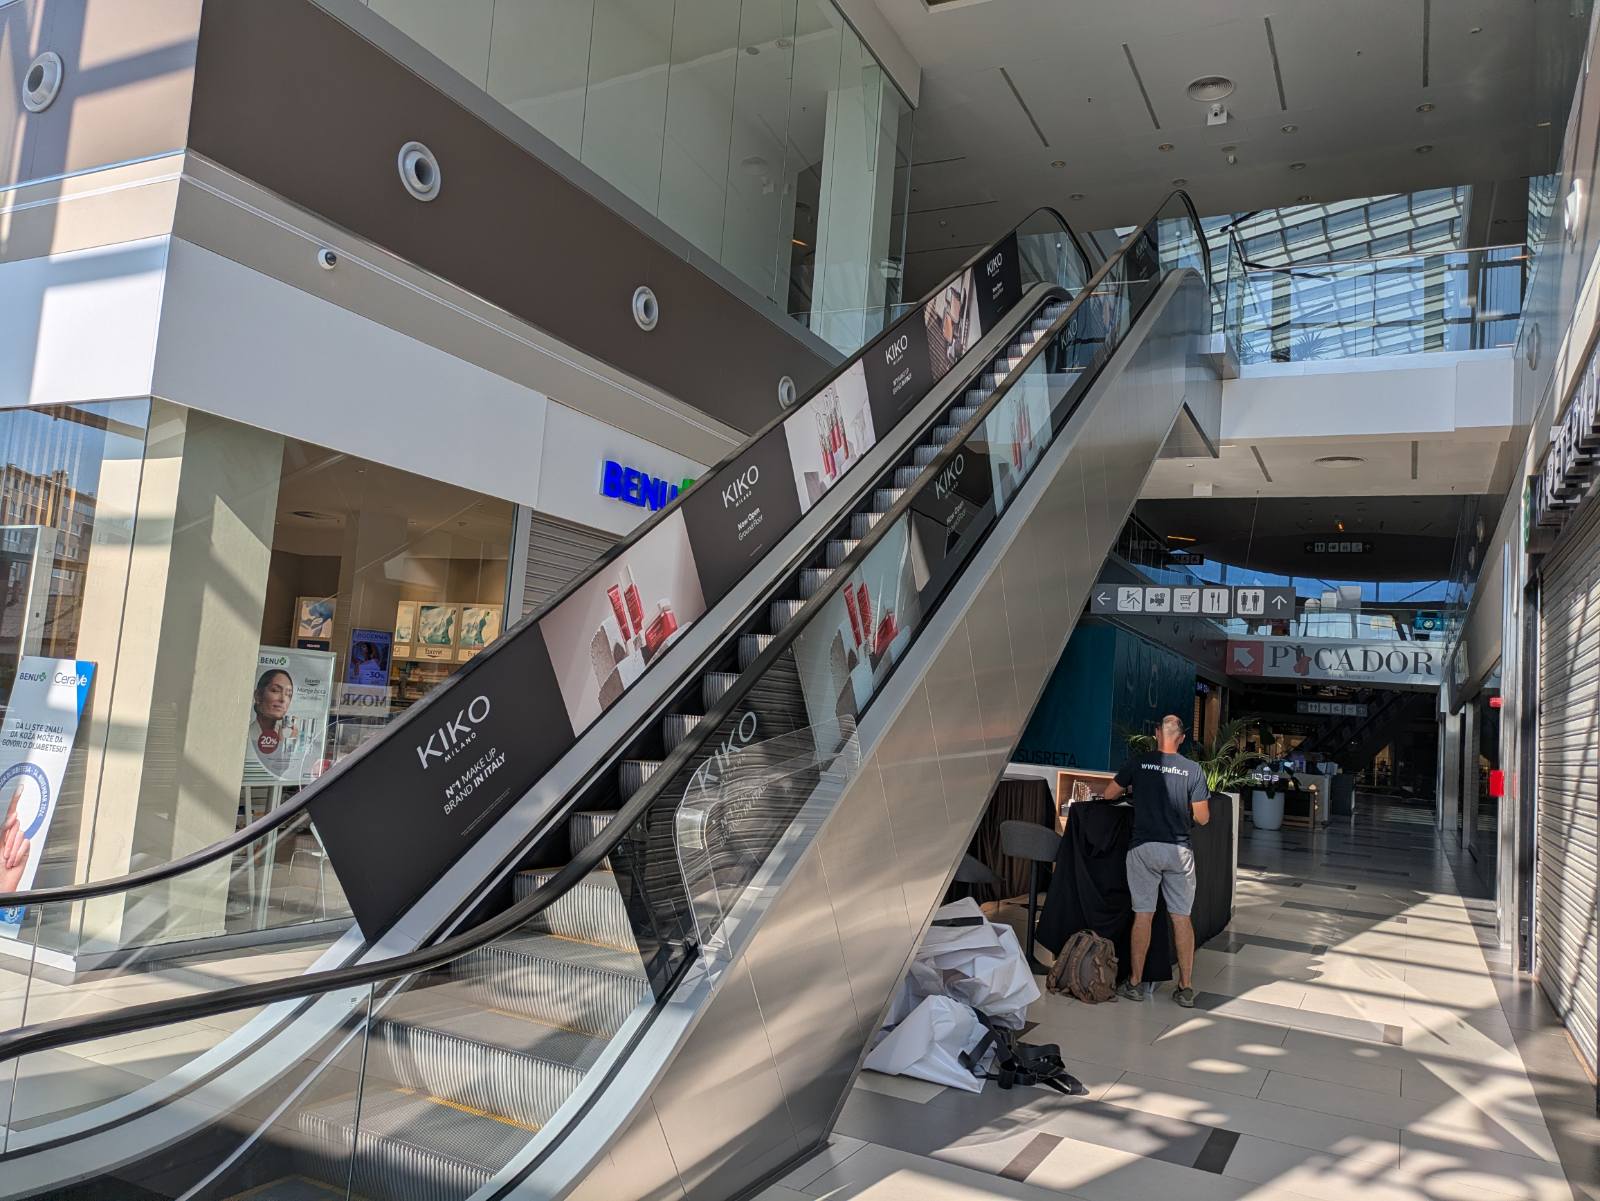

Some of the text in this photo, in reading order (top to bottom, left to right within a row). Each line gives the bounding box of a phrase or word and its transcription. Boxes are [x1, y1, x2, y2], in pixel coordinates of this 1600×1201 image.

[885, 334, 908, 365] KIKO
[722, 465, 759, 508] KIKO
[935, 453, 964, 500] KIKO
[260, 656, 279, 665] BENU
[20, 672, 88, 687] BENU CeraVe
[32, 723, 44, 731] STE
[44, 725, 63, 734] ZNALI
[260, 735, 278, 746] 20%
[416, 695, 490, 769] KIKO
[444, 732, 476, 763] MILANO
[697, 711, 757, 793] KIKO
[461, 758, 486, 784] MAKE
[484, 747, 497, 761] UP
[443, 784, 473, 815] BRAND
[473, 773, 484, 788] IN
[483, 752, 506, 778] ITALY
